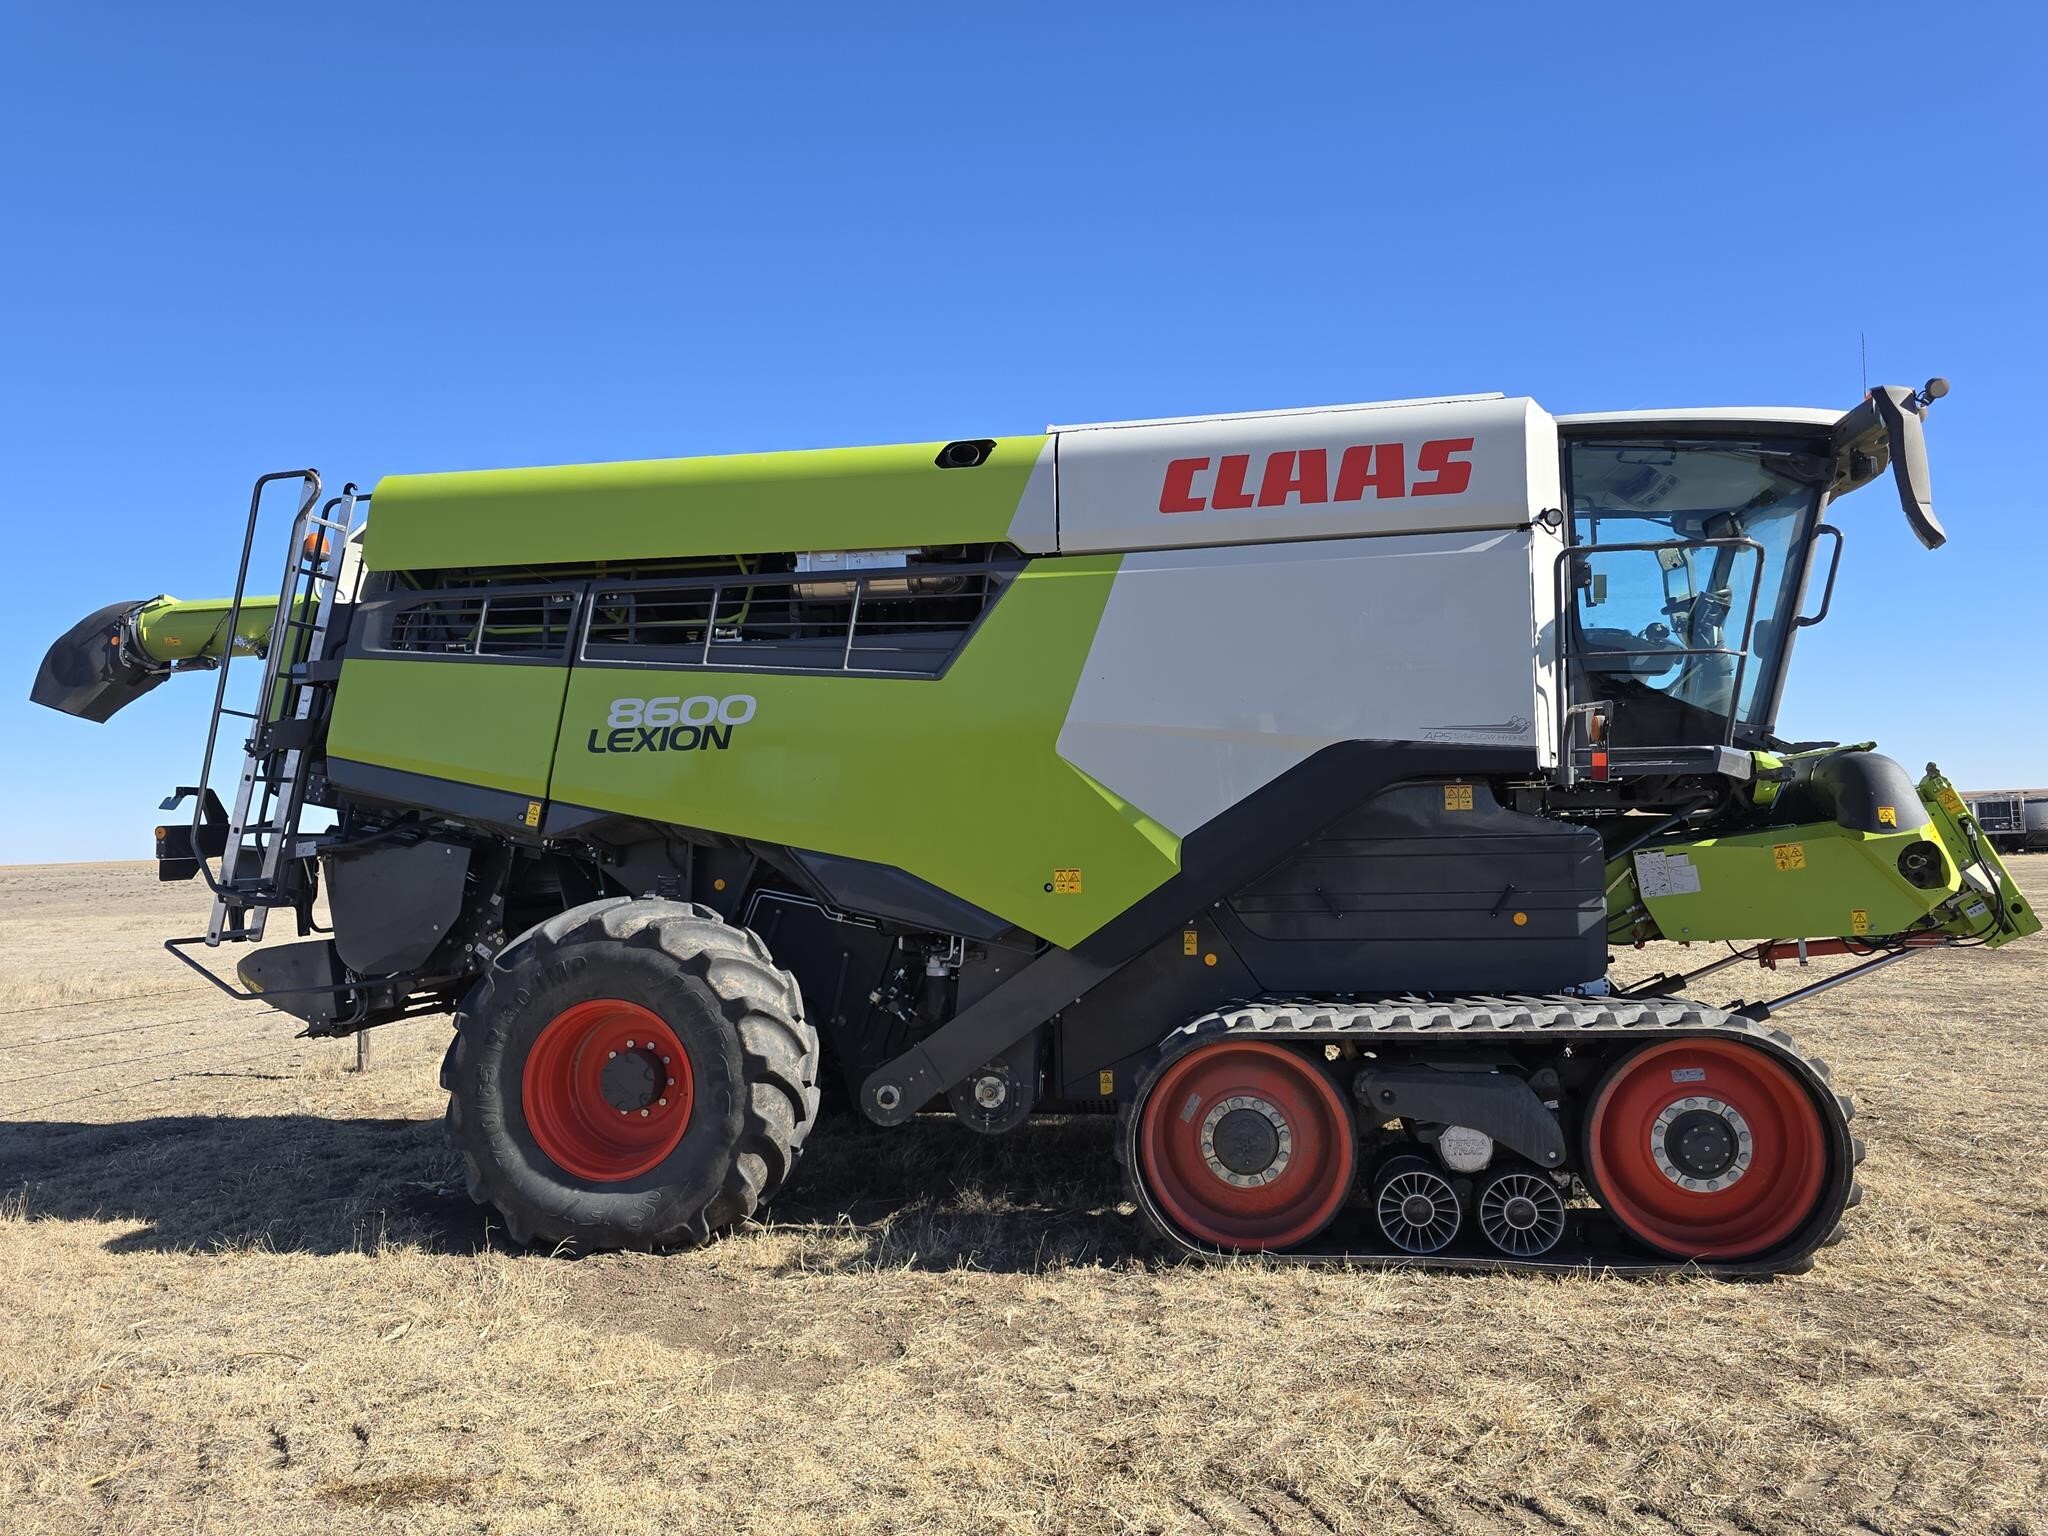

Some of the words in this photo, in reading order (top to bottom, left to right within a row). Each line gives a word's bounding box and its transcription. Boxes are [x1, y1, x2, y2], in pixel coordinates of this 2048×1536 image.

[1159, 437, 1474, 513] CLAAS
[607, 694, 757, 729] 8600
[587, 724, 733, 753] LEXION
[1424, 731, 1452, 741] APS
